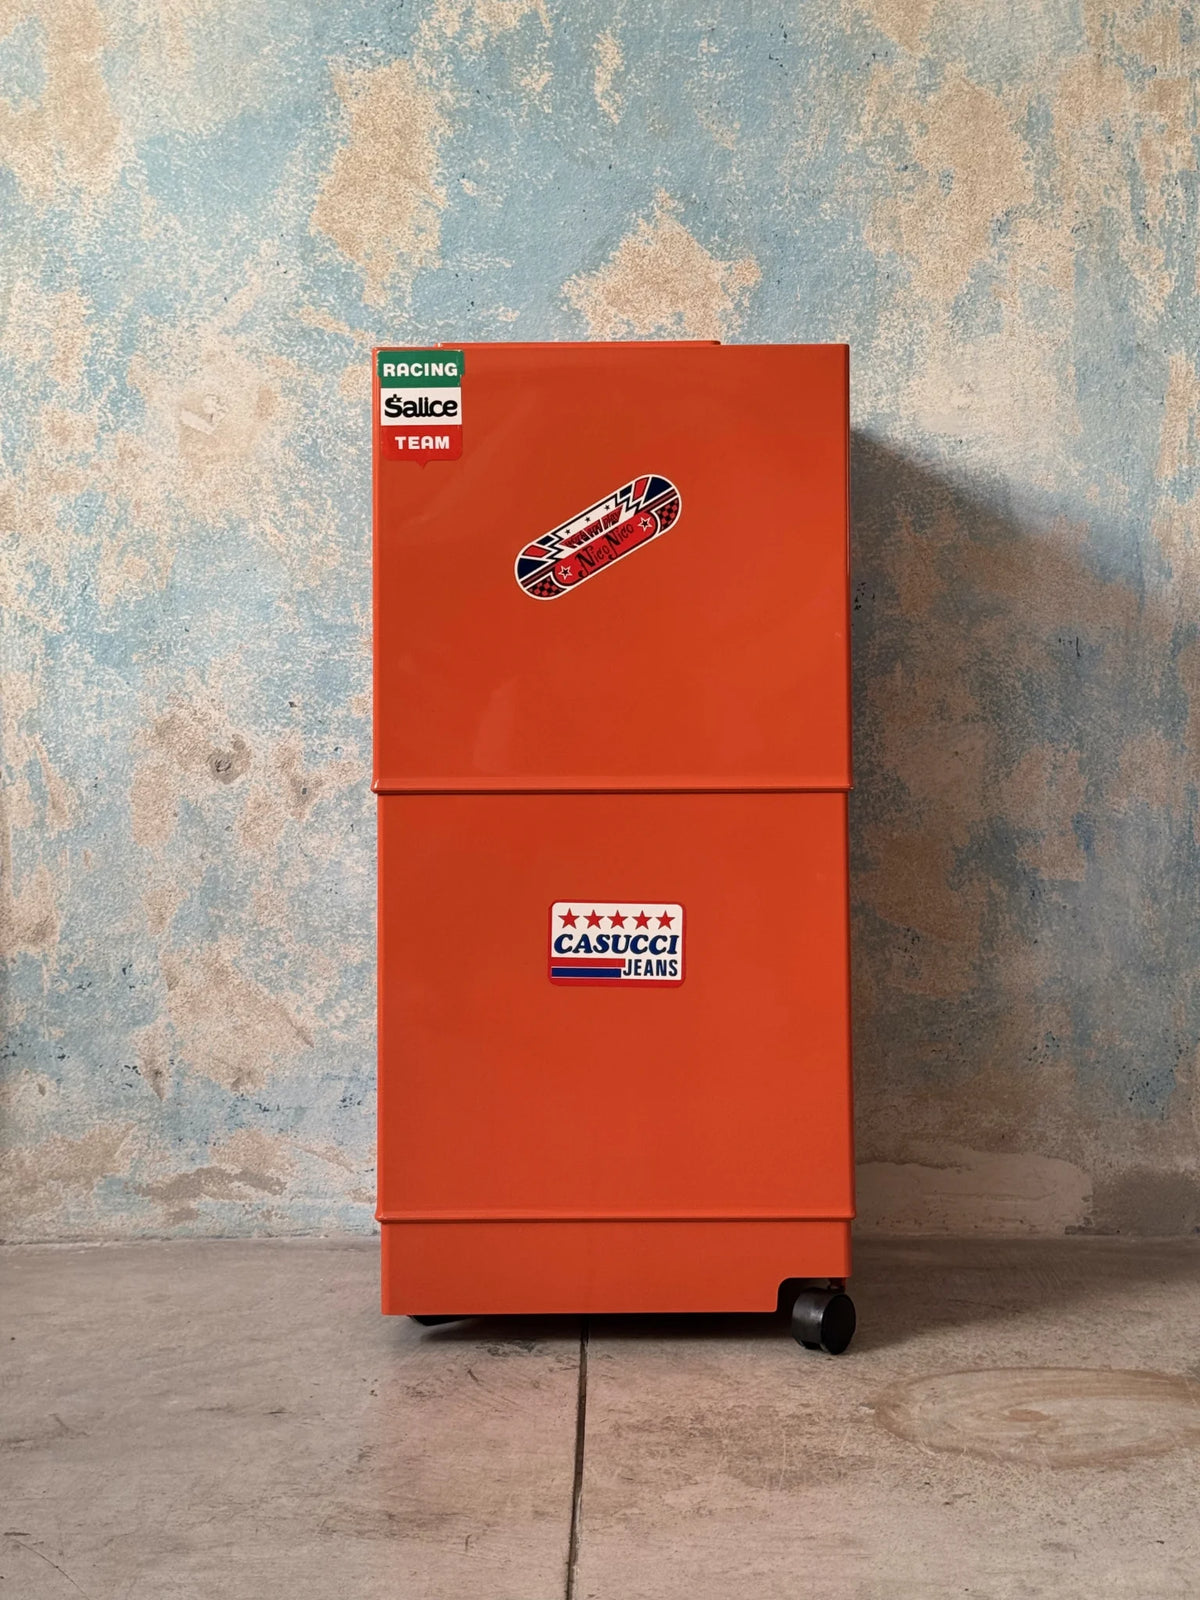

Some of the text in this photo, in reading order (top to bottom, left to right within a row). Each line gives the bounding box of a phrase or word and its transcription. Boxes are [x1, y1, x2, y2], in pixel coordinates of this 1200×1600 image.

[383, 363, 458, 377] RACING
[384, 394, 458, 418] Salice
[395, 436, 450, 450] TEAM
[575, 523, 634, 578] Nico Nico
[554, 933, 680, 956] CASUCCI
[622, 958, 679, 977] JEANS
